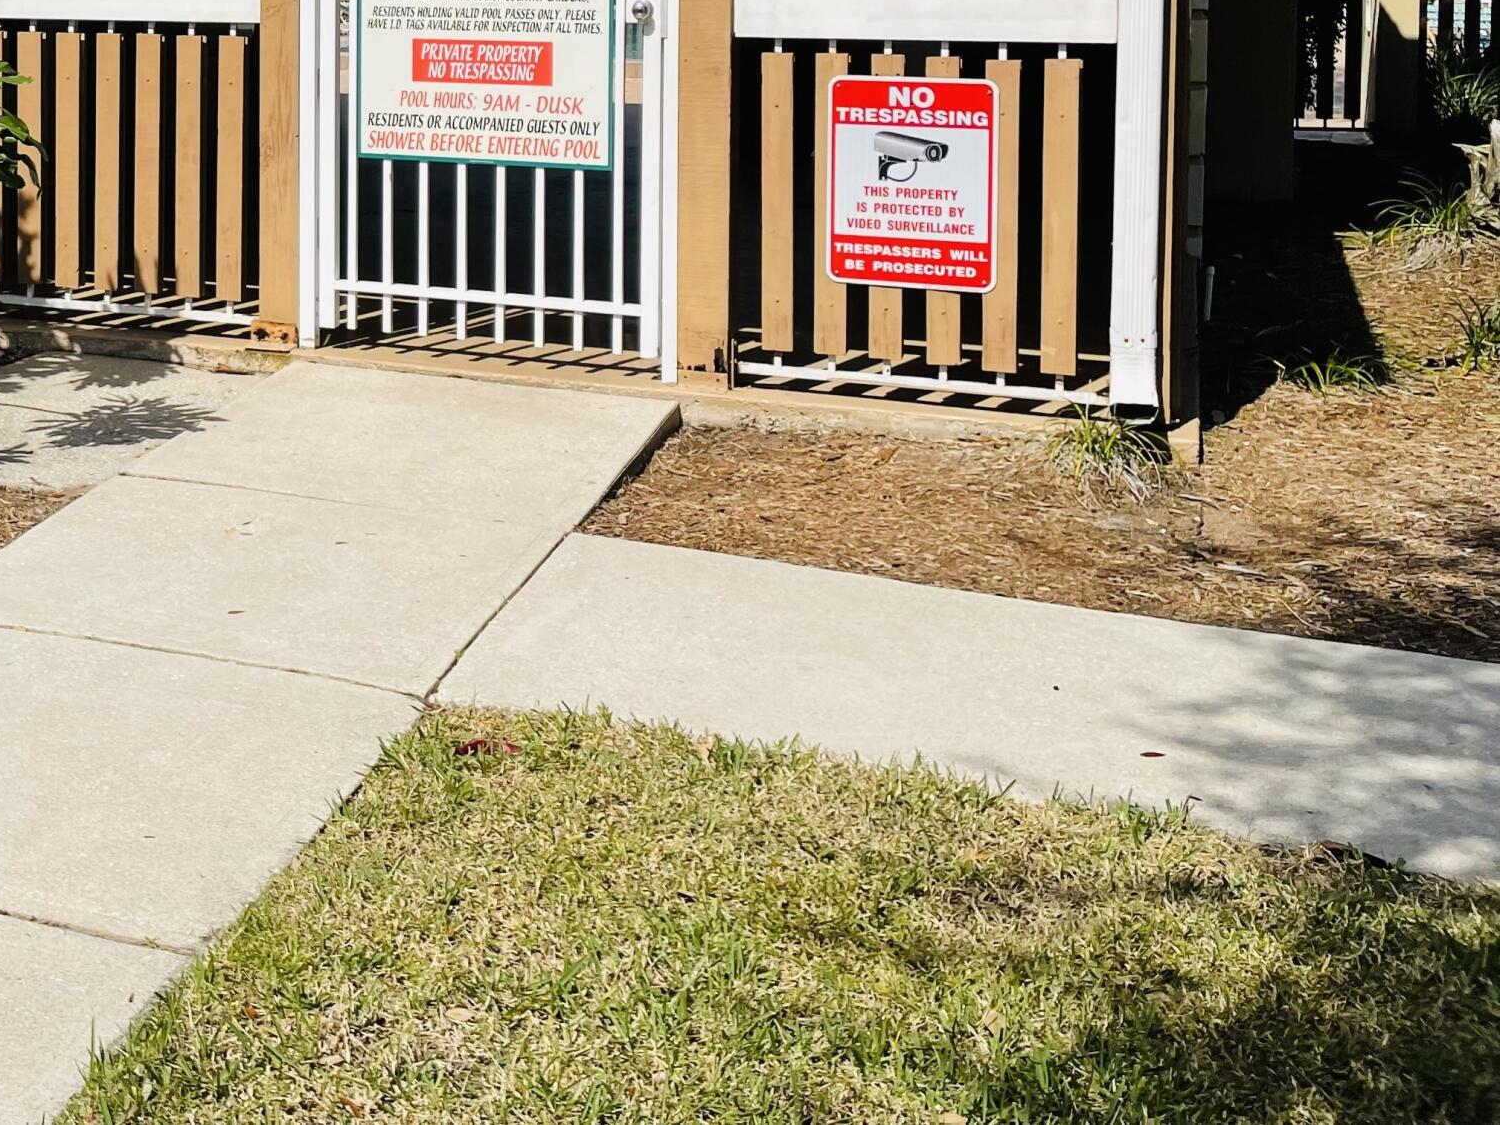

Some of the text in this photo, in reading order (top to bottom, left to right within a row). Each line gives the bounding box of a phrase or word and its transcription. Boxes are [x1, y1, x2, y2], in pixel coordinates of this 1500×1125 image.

[373, 7, 415, 17] RESIDENTS
[417, 7, 452, 18] HOLDING
[455, 8, 480, 19] VALID
[482, 8, 502, 20] POOL
[505, 9, 536, 20] PASSES
[566, 10, 596, 21] PLEASE
[368, 20, 603, 34] HAVE I.D. TAGS AVAILABLE FOR INSPECTION AT ALL TIMES.
[421, 43, 543, 63] PRIVATE PROPERTY
[428, 61, 535, 81] NO TRESPASSING
[400, 91, 429, 107] POOL
[434, 92, 477, 109] HOURS:
[483, 94, 521, 112] 9AM
[536, 96, 585, 115] DUSK
[889, 86, 935, 109] NO
[368, 112, 600, 136] RESIDENTS OR ACCOMPANIED GUESTS ONLY
[836, 107, 988, 126] TRESPASSING
[368, 130, 601, 159] SHOWER BEFORE ENTERING POOL
[863, 186, 958, 200] THIS PROPERTY
[856, 202, 964, 218] IS PROTECTED BY
[847, 218, 975, 235] VIDEO SURVEILLANCE
[834, 243, 988, 262] TRESPASSERS WILL
[845, 260, 976, 277] BE PROSECUTED
